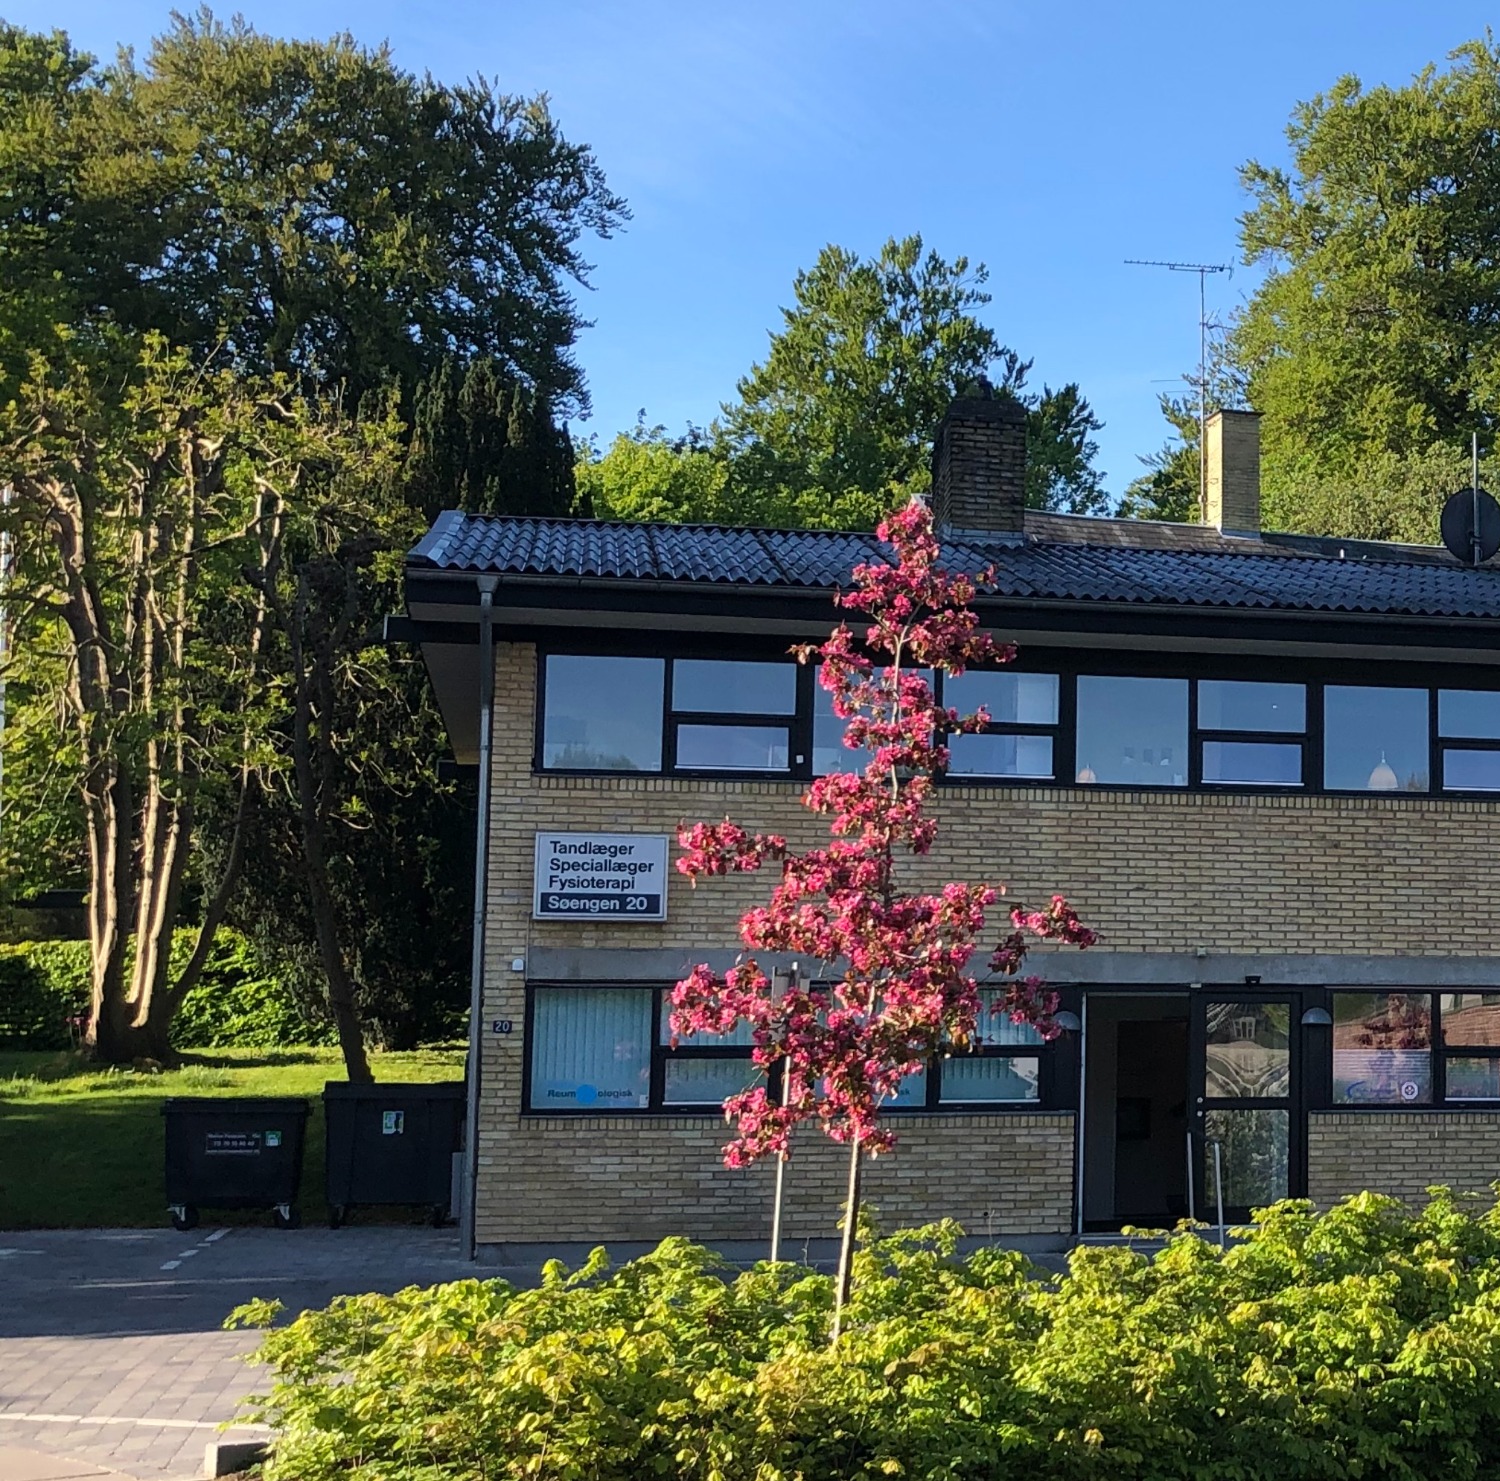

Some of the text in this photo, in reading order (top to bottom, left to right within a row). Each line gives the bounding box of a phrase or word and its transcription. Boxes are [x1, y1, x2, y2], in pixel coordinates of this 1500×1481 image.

[549, 840, 635, 858] Tandlæger
[549, 858, 654, 875] Speciallæger
[548, 875, 635, 892] Fysioterapi
[548, 895, 648, 913] Søengen 20
[495, 1020, 510, 1032] 20
